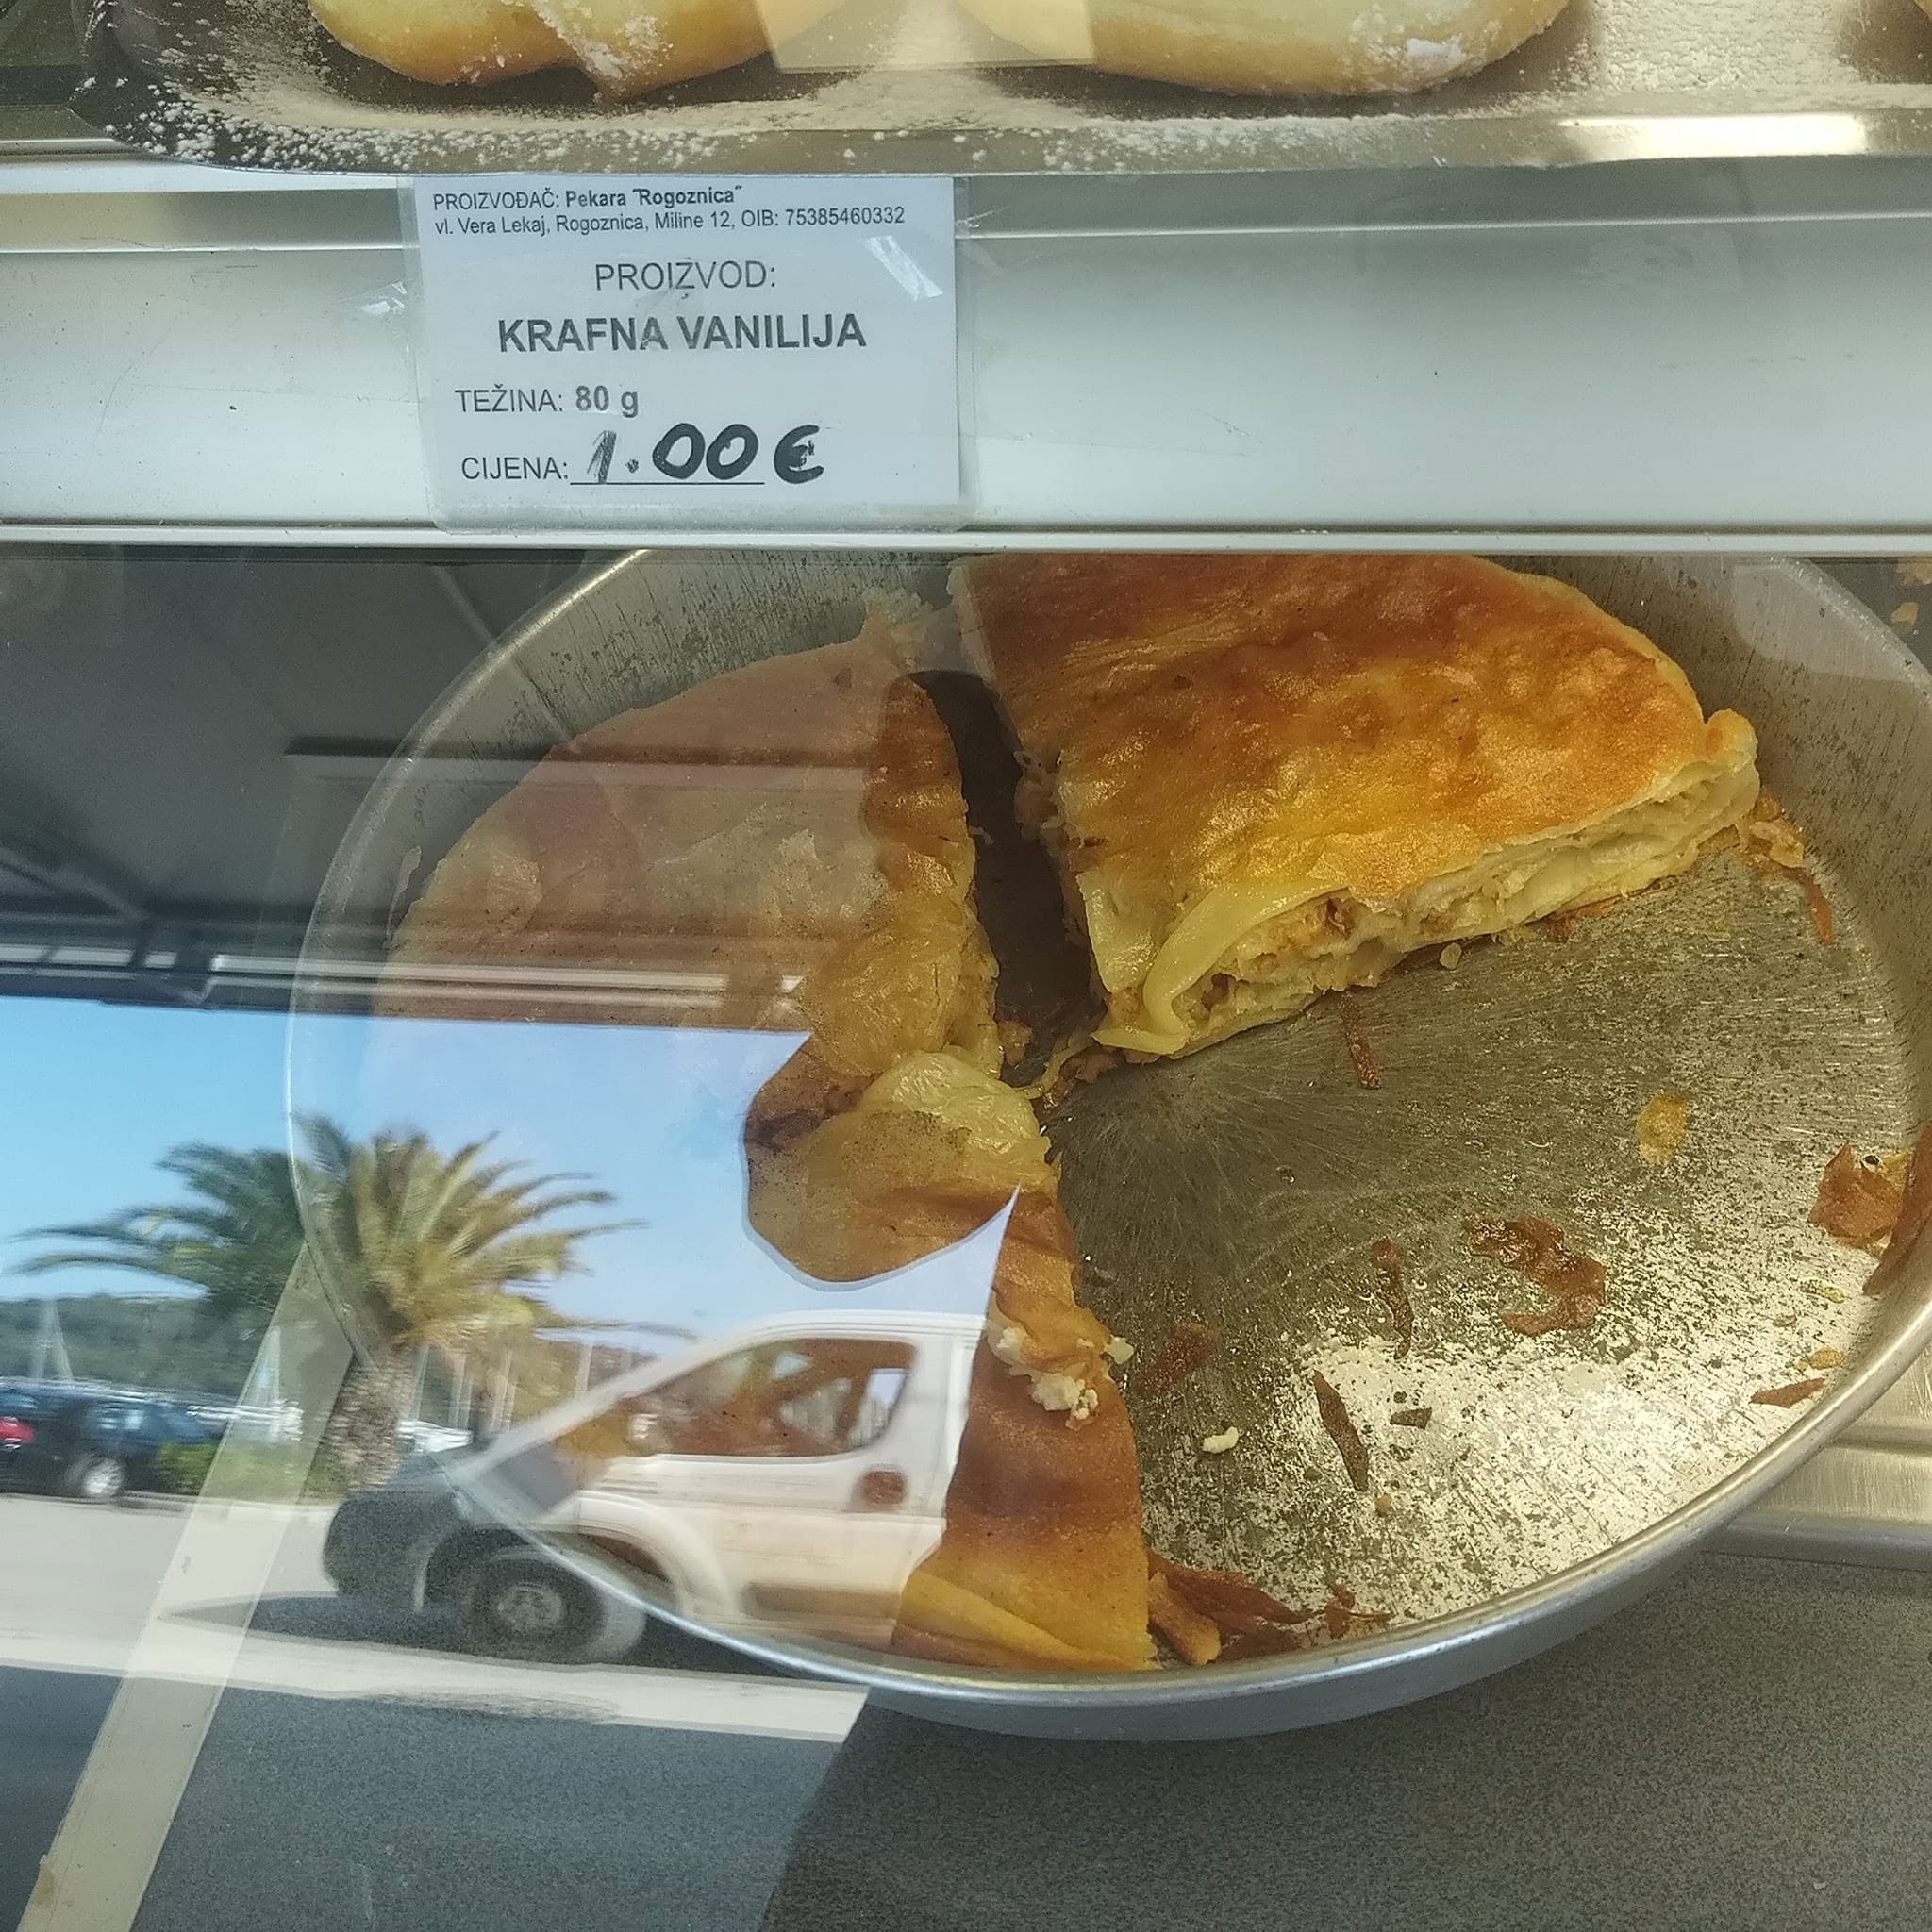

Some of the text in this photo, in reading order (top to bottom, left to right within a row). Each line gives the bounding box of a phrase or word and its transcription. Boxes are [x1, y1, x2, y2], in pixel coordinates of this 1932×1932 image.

[433, 188, 559, 210] PROIZVOĐAČ:
[565, 190, 626, 208] Pekara
[435, 206, 906, 237] vl. Vera Lekaj, Rogoznica, Miline 12, OIB: 75385460332
[595, 260, 775, 291] PROIZVOD:
[498, 313, 867, 352] KRAFNA VANILIJA
[455, 384, 639, 418] TEŽINA: 80 g
[461, 456, 568, 481] CIJENA:
